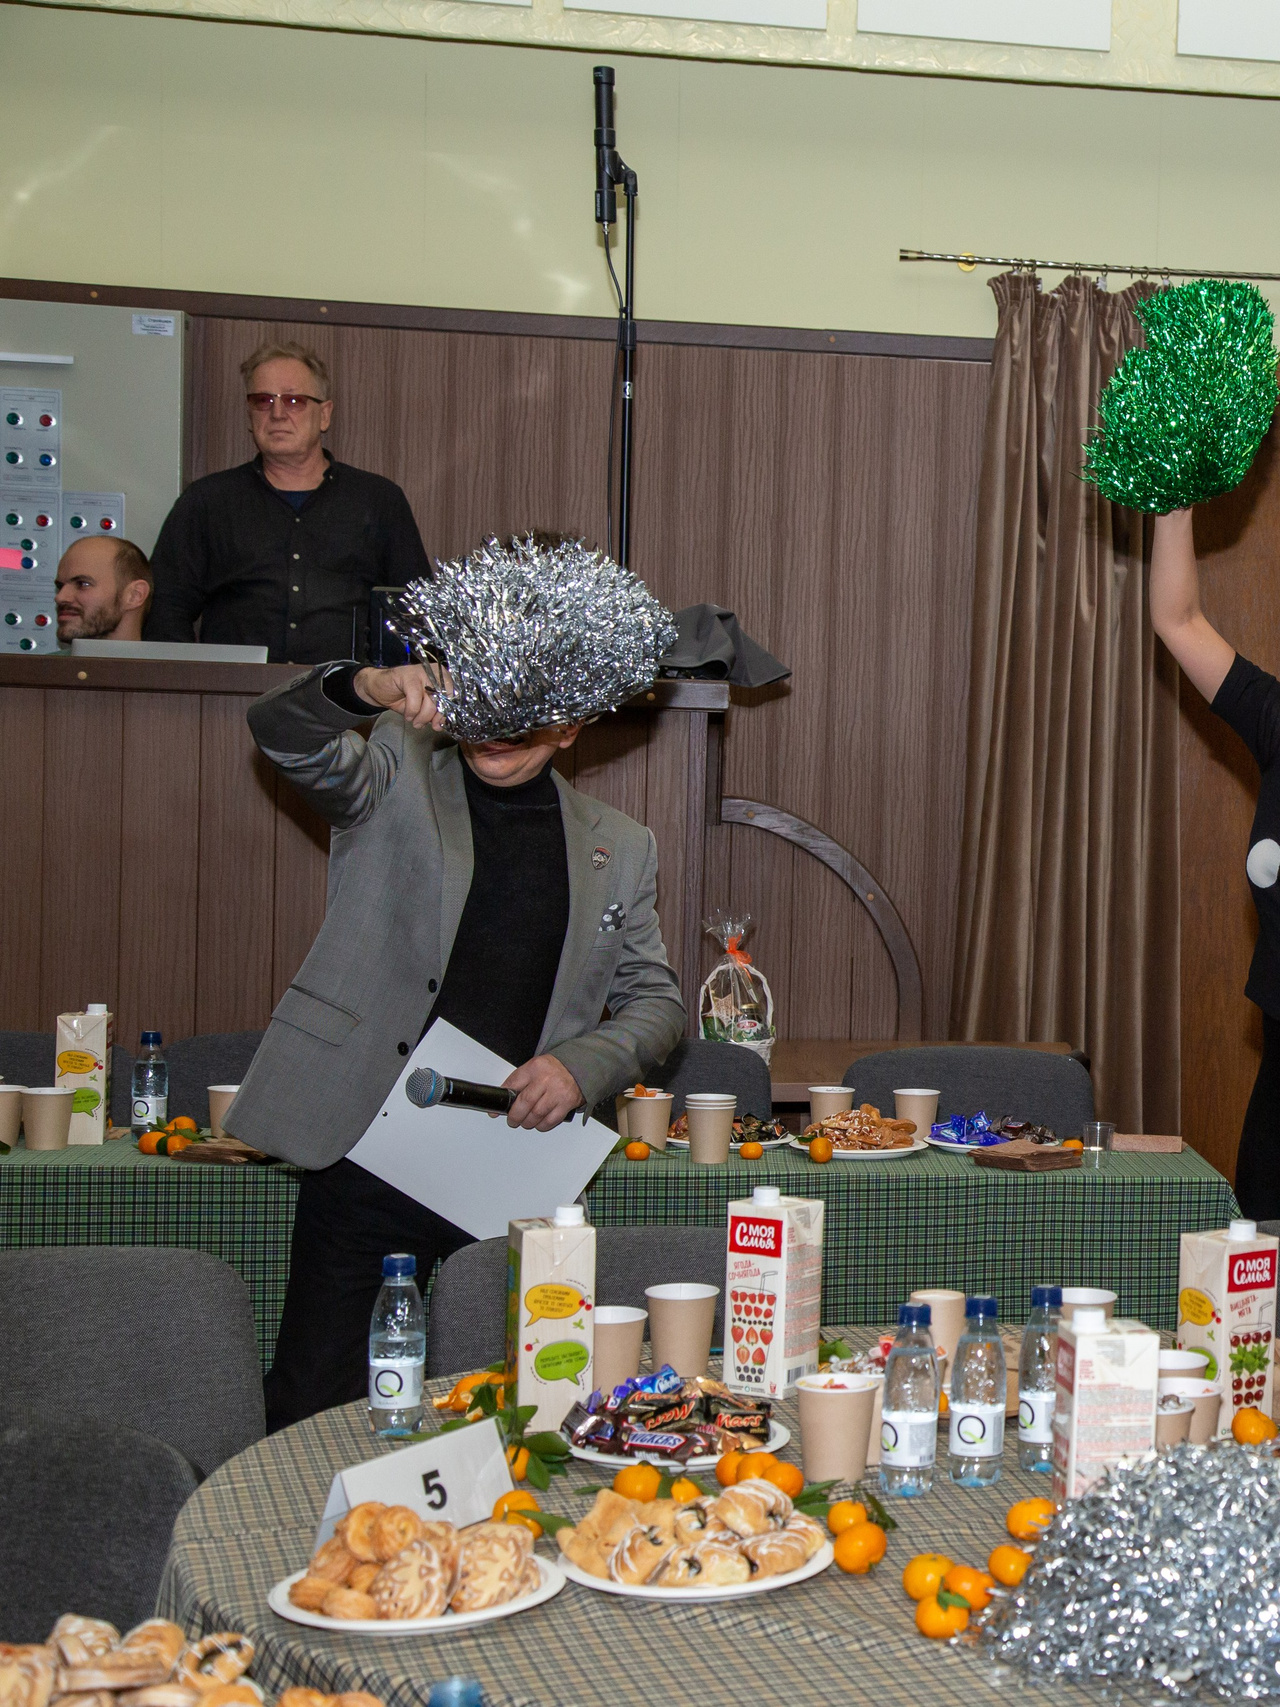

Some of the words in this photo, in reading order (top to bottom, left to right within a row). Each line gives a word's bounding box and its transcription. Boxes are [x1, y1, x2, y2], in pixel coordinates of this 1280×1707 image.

[735, 1222, 776, 1250] Семья
[749, 1224, 775, 1238] МОЯ
[1233, 1259, 1272, 1285] Семья
[1246, 1257, 1271, 1272] МОЯ
[715, 1413, 763, 1428] Mars
[421, 1469, 448, 1511] 5
